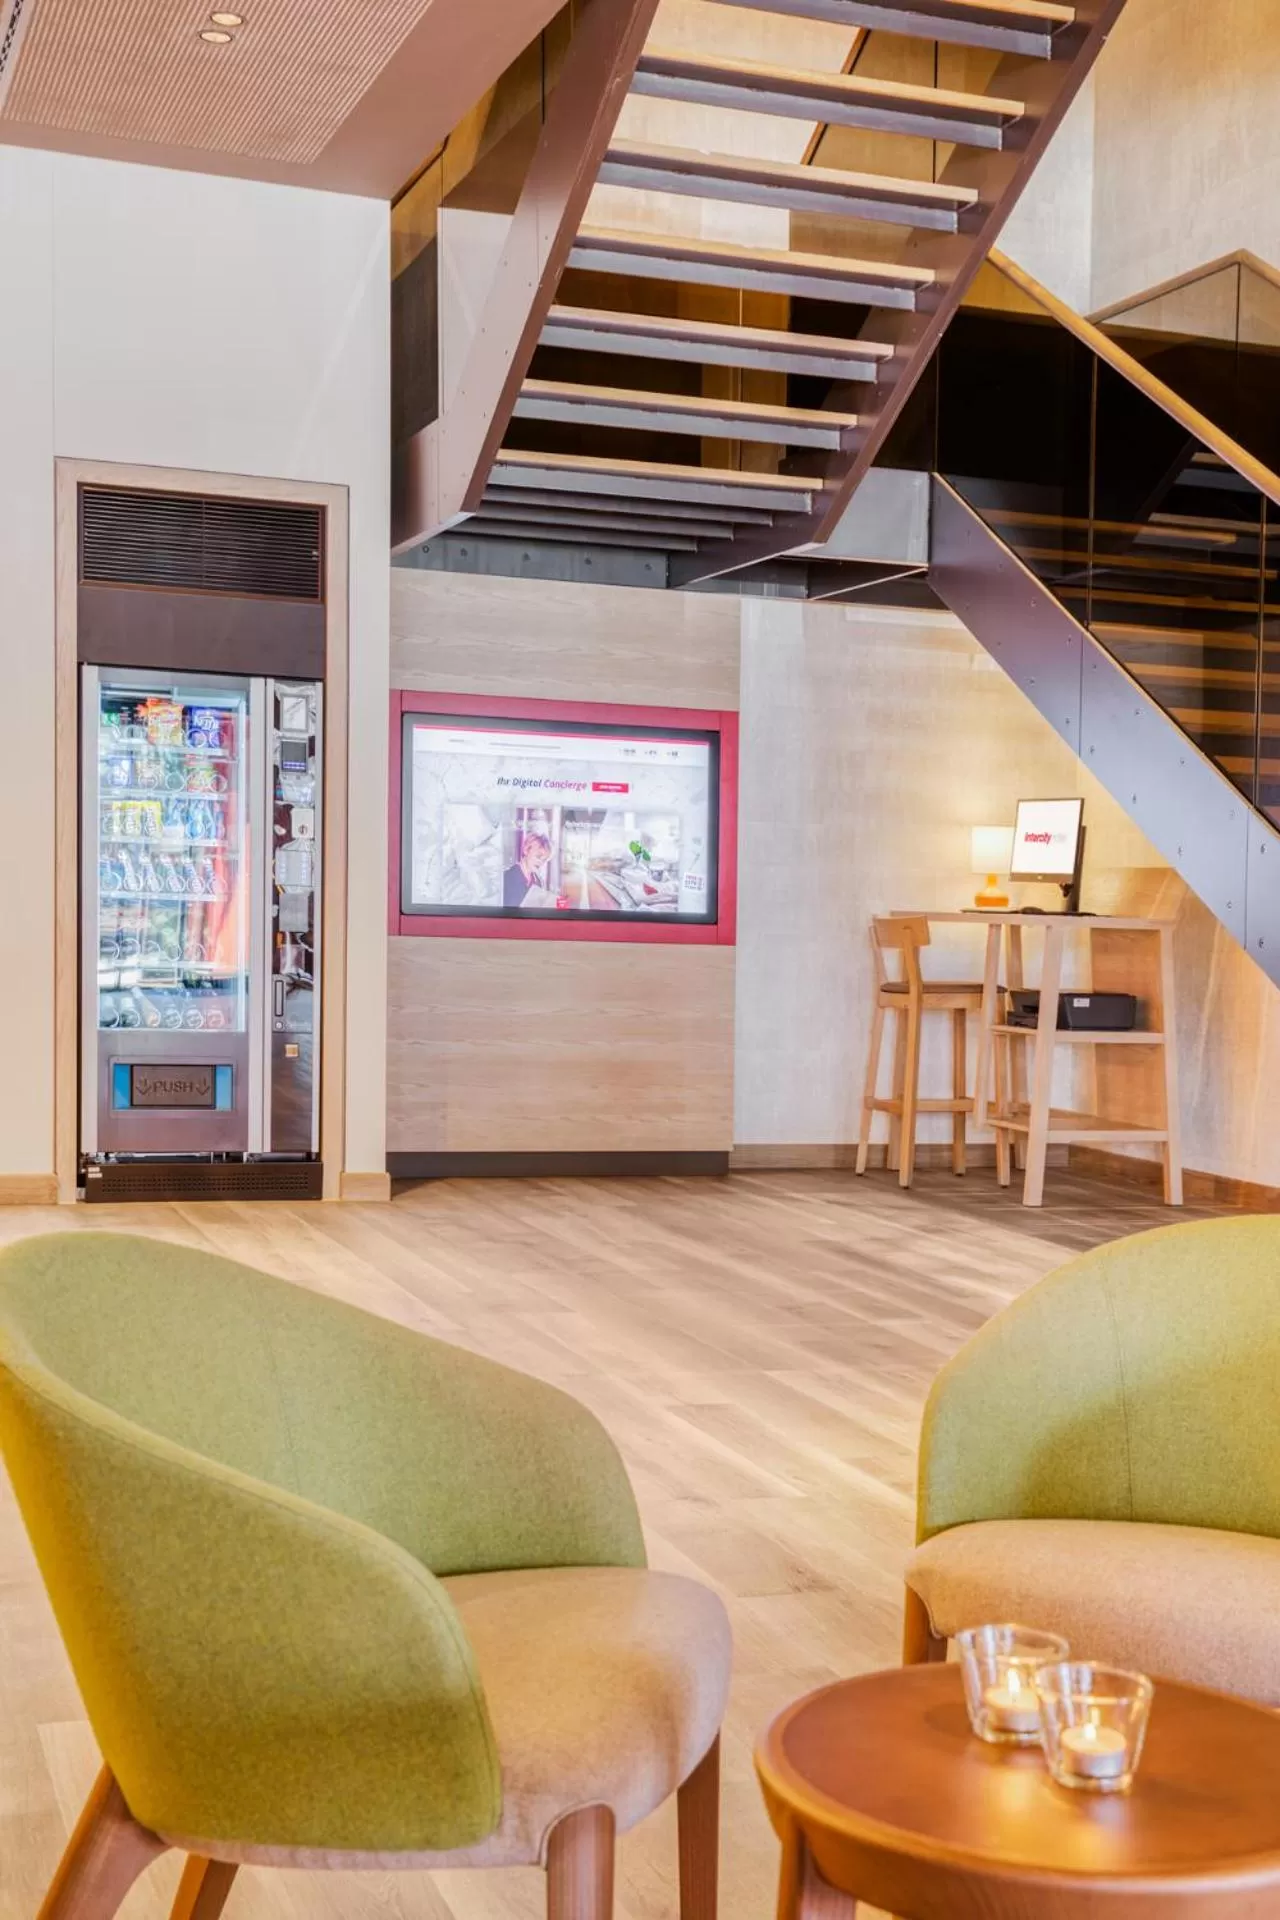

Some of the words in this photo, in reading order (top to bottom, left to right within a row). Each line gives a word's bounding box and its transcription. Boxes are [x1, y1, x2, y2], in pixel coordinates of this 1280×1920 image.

[512, 777, 542, 789] Digital
[544, 779, 587, 791] Concierge
[153, 1080, 193, 1093] PUSH
